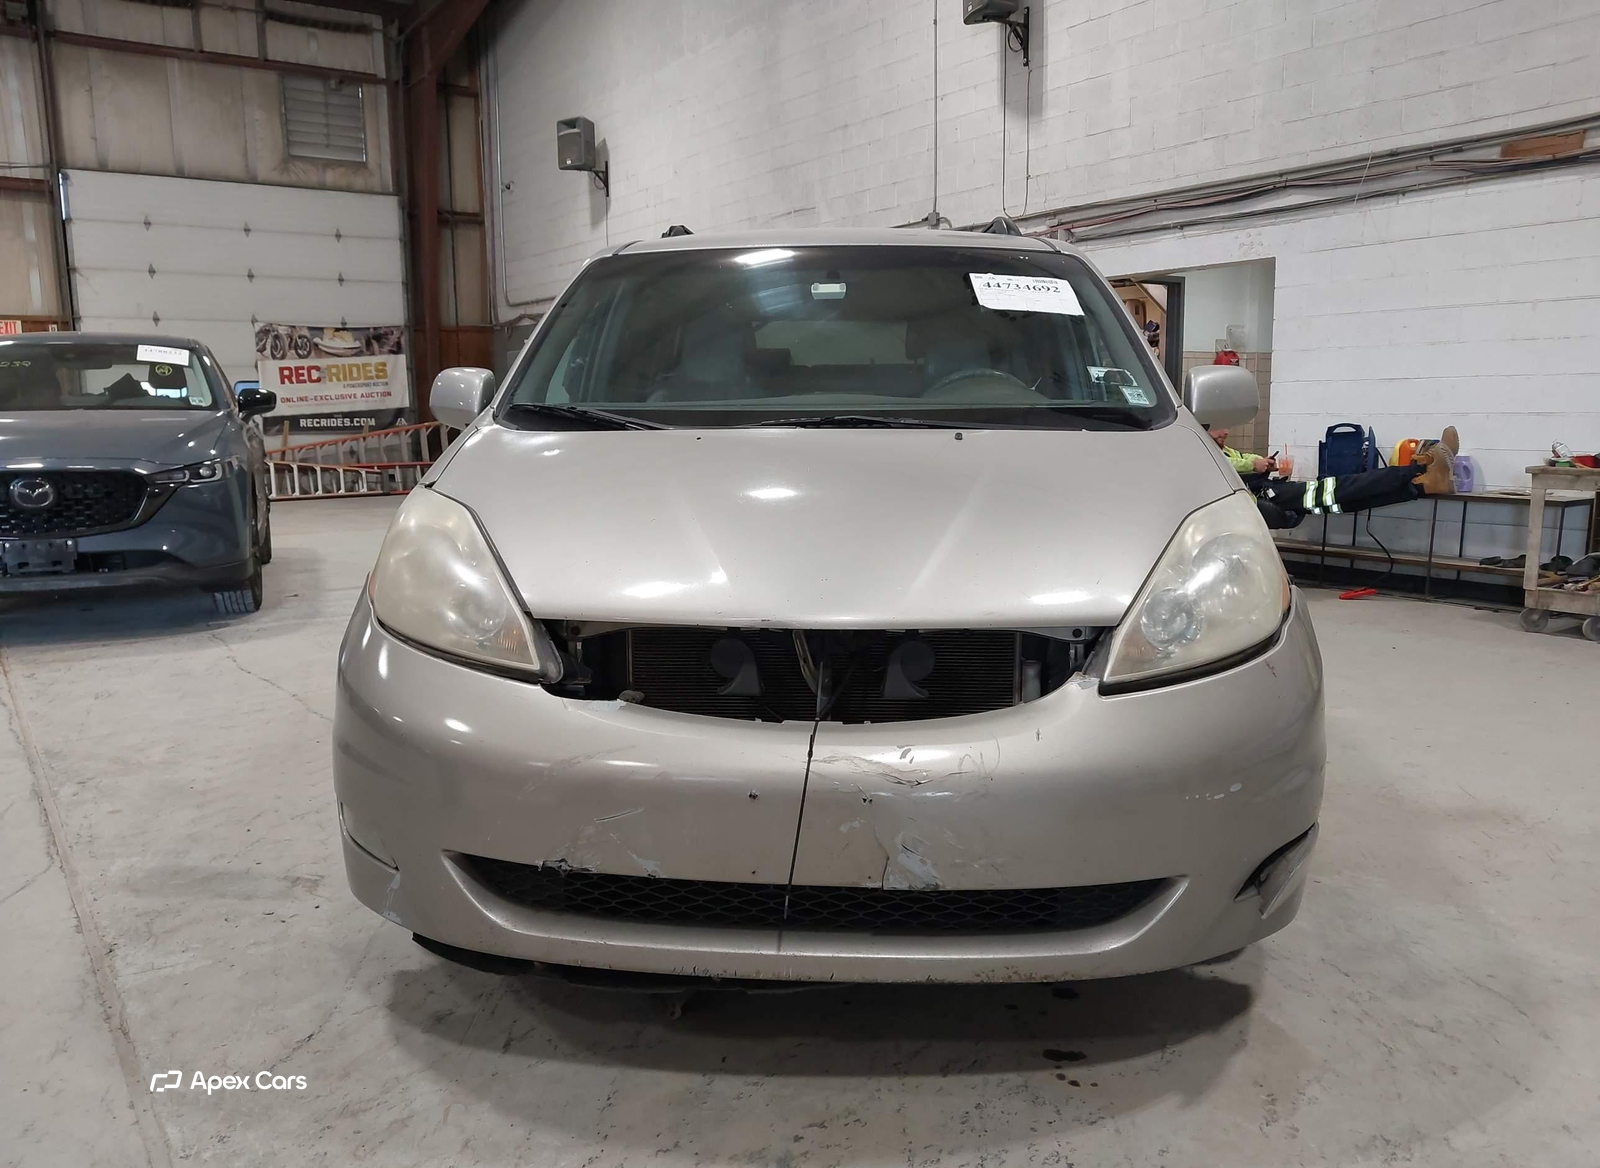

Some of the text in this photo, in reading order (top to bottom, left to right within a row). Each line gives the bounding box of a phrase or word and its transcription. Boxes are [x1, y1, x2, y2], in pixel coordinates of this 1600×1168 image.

[982, 281, 1061, 294] 44734692
[278, 365, 322, 385] REC
[326, 361, 388, 383] RIDES
[280, 391, 392, 403] ONLINE-EXCLUSIVE AUCTION
[300, 417, 376, 428] RECRIDES.COM
